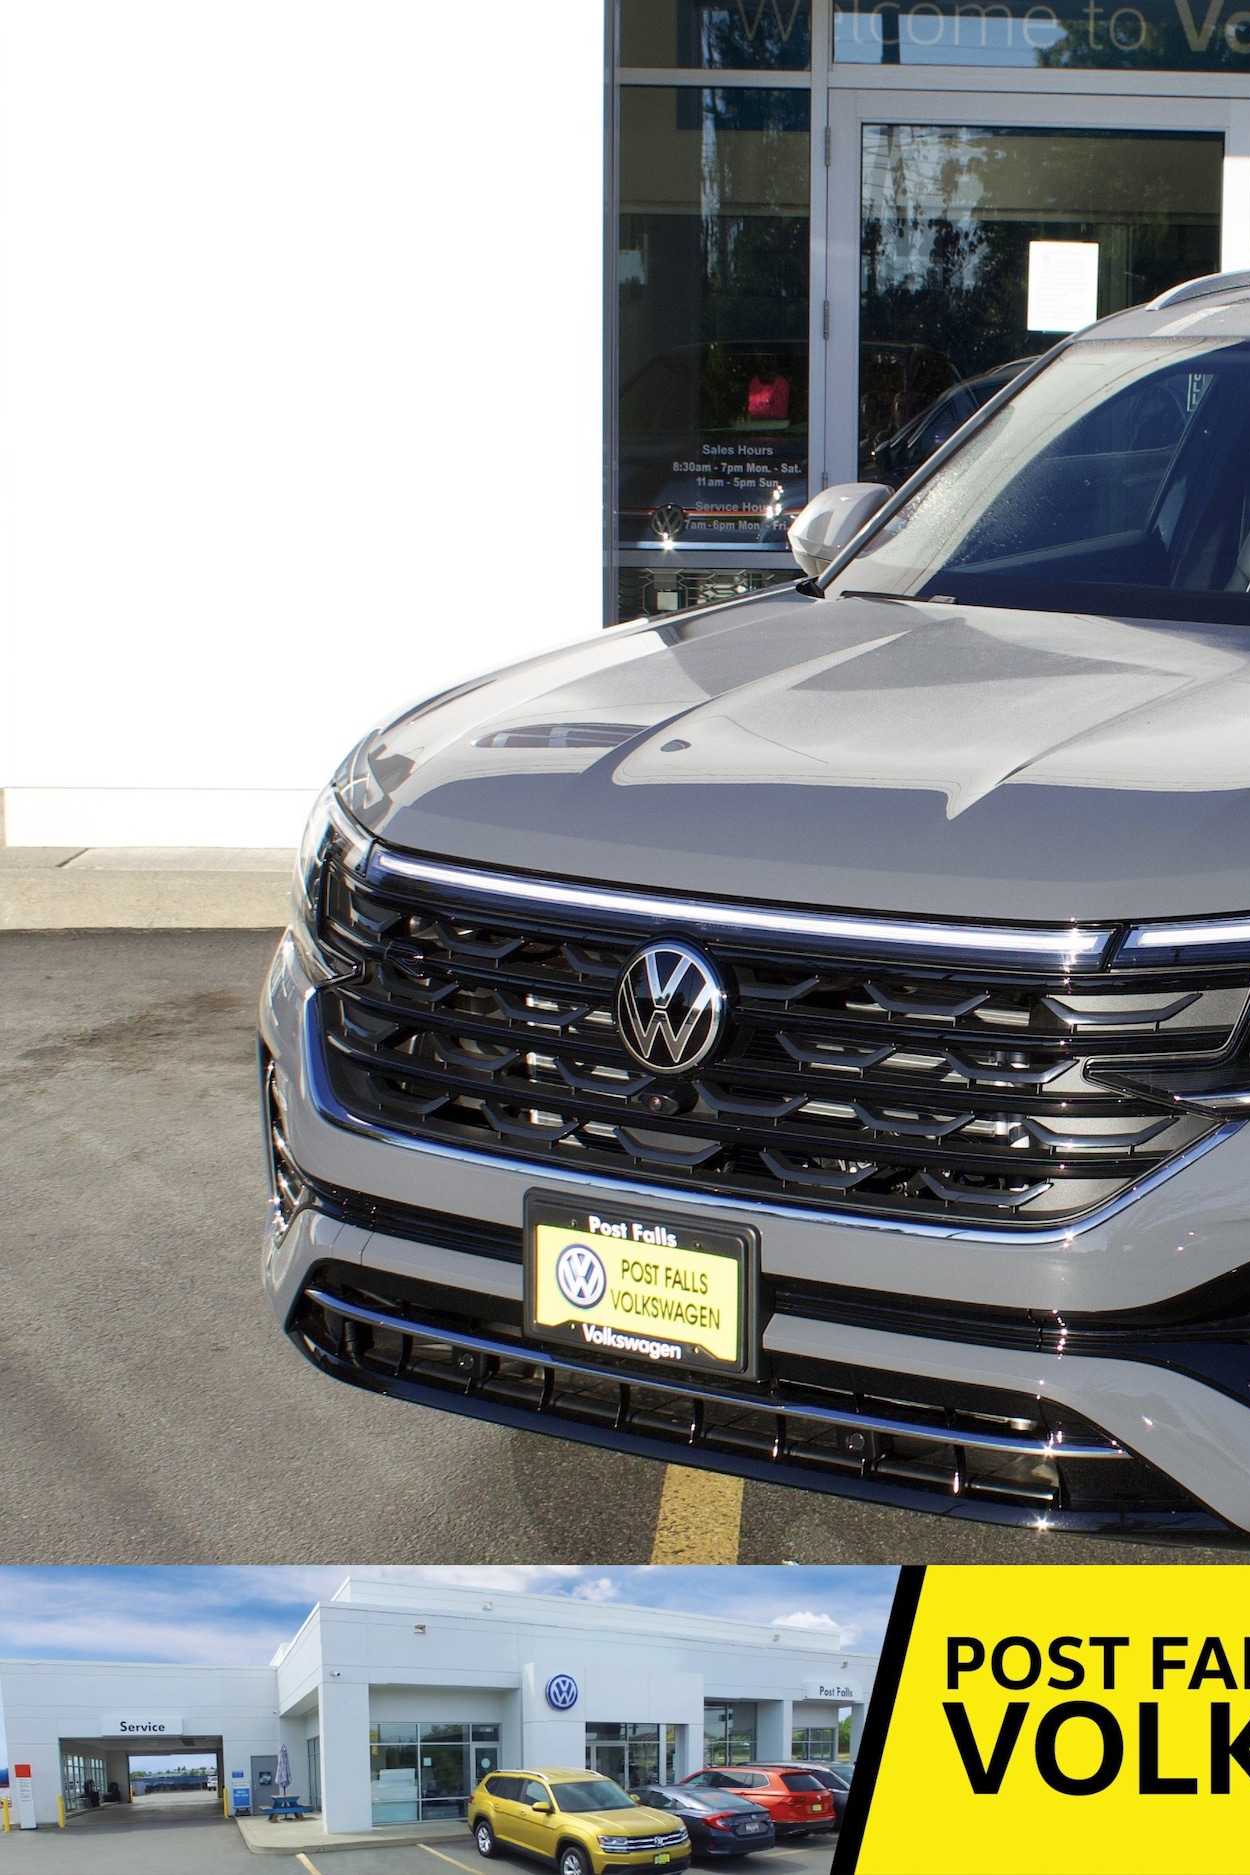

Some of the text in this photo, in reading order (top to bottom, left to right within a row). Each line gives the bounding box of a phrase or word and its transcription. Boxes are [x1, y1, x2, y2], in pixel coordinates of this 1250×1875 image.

[737, 0, 1058, 48] Wlcome
[1083, 0, 1147, 50] to
[702, 445, 774, 456] Sales Hours
[672, 462, 711, 472] 8:30am
[721, 463, 744, 475] 7pm
[746, 464, 771, 473] Mon.
[781, 464, 802, 474] Sat.
[696, 477, 724, 487] 11am
[733, 478, 756, 489] 5pm
[695, 502, 778, 512] Service Hou
[588, 1215, 678, 1248] Post Falls
[621, 1258, 708, 1295] POST FALLS
[610, 1288, 720, 1330] VOLKSWAGEN
[582, 1323, 682, 1360] Volkswagen
